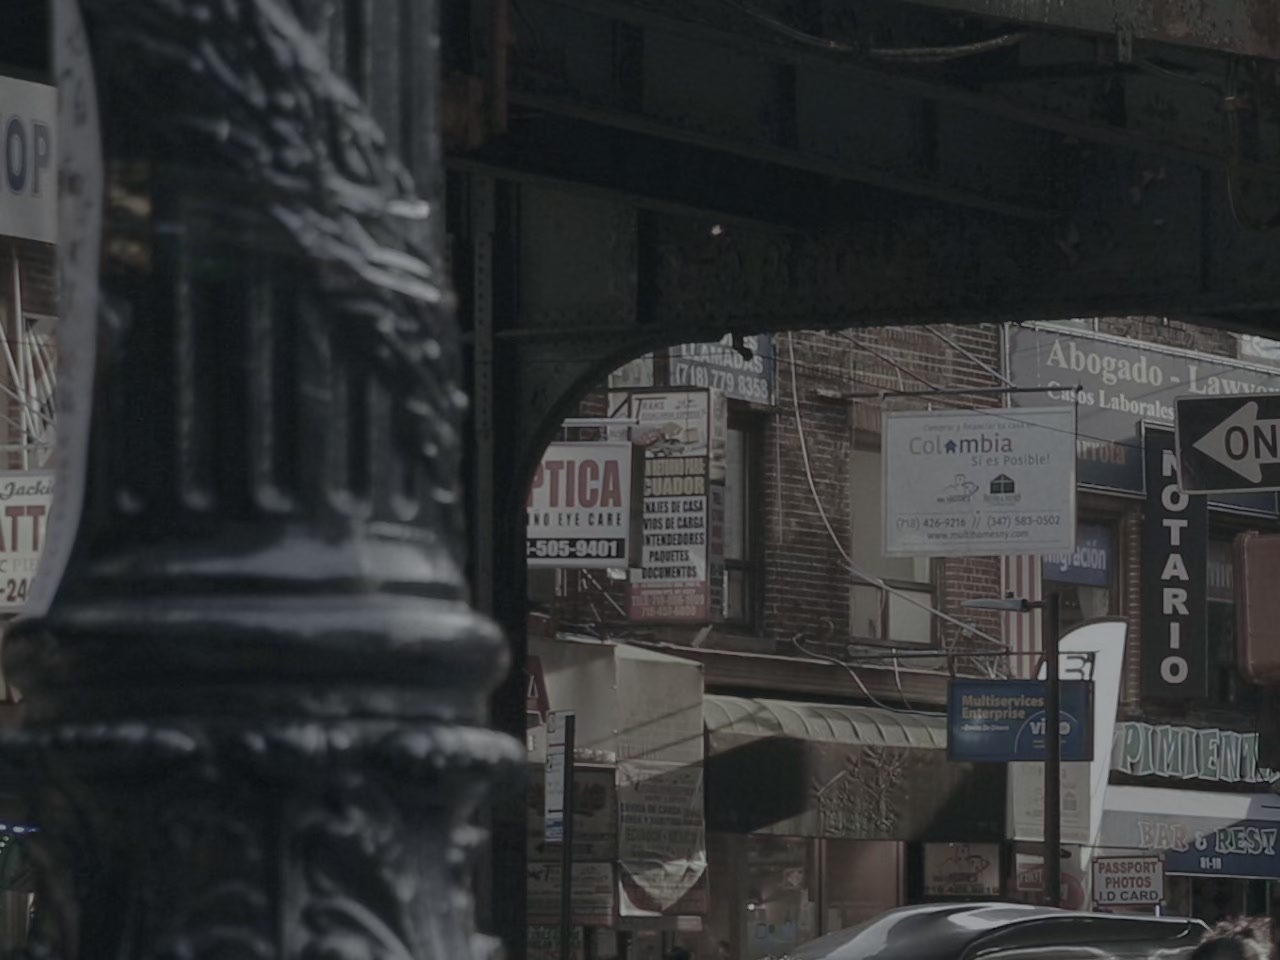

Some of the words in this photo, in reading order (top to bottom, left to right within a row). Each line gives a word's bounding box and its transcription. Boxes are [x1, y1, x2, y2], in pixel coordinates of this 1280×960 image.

[1046, 339, 1163, 386] Abogado
[711, 370, 735, 392] 779
[738, 374, 769, 399] 8358
[1099, 390, 1175, 420] Laborales
[909, 433, 1014, 456] Colmbia
[558, 511, 580, 527] EYE
[588, 511, 622, 527] CARE
[1015, 515, 1061, 526] 583-0502
[642, 566, 697, 580] DOCUMENTOS
[1160, 449, 1190, 685] NOTARIO
[962, 694, 1045, 707] Multiservices
[962, 708, 1026, 721] Enterprise
[1029, 718, 1073, 736] vio
[1137, 820, 1189, 852] BAR
[1215, 827, 1278, 856] REST
[1098, 861, 1157, 874] PASSPORT
[1105, 876, 1152, 888] PHOTOS
[1120, 891, 1159, 901] CARD
